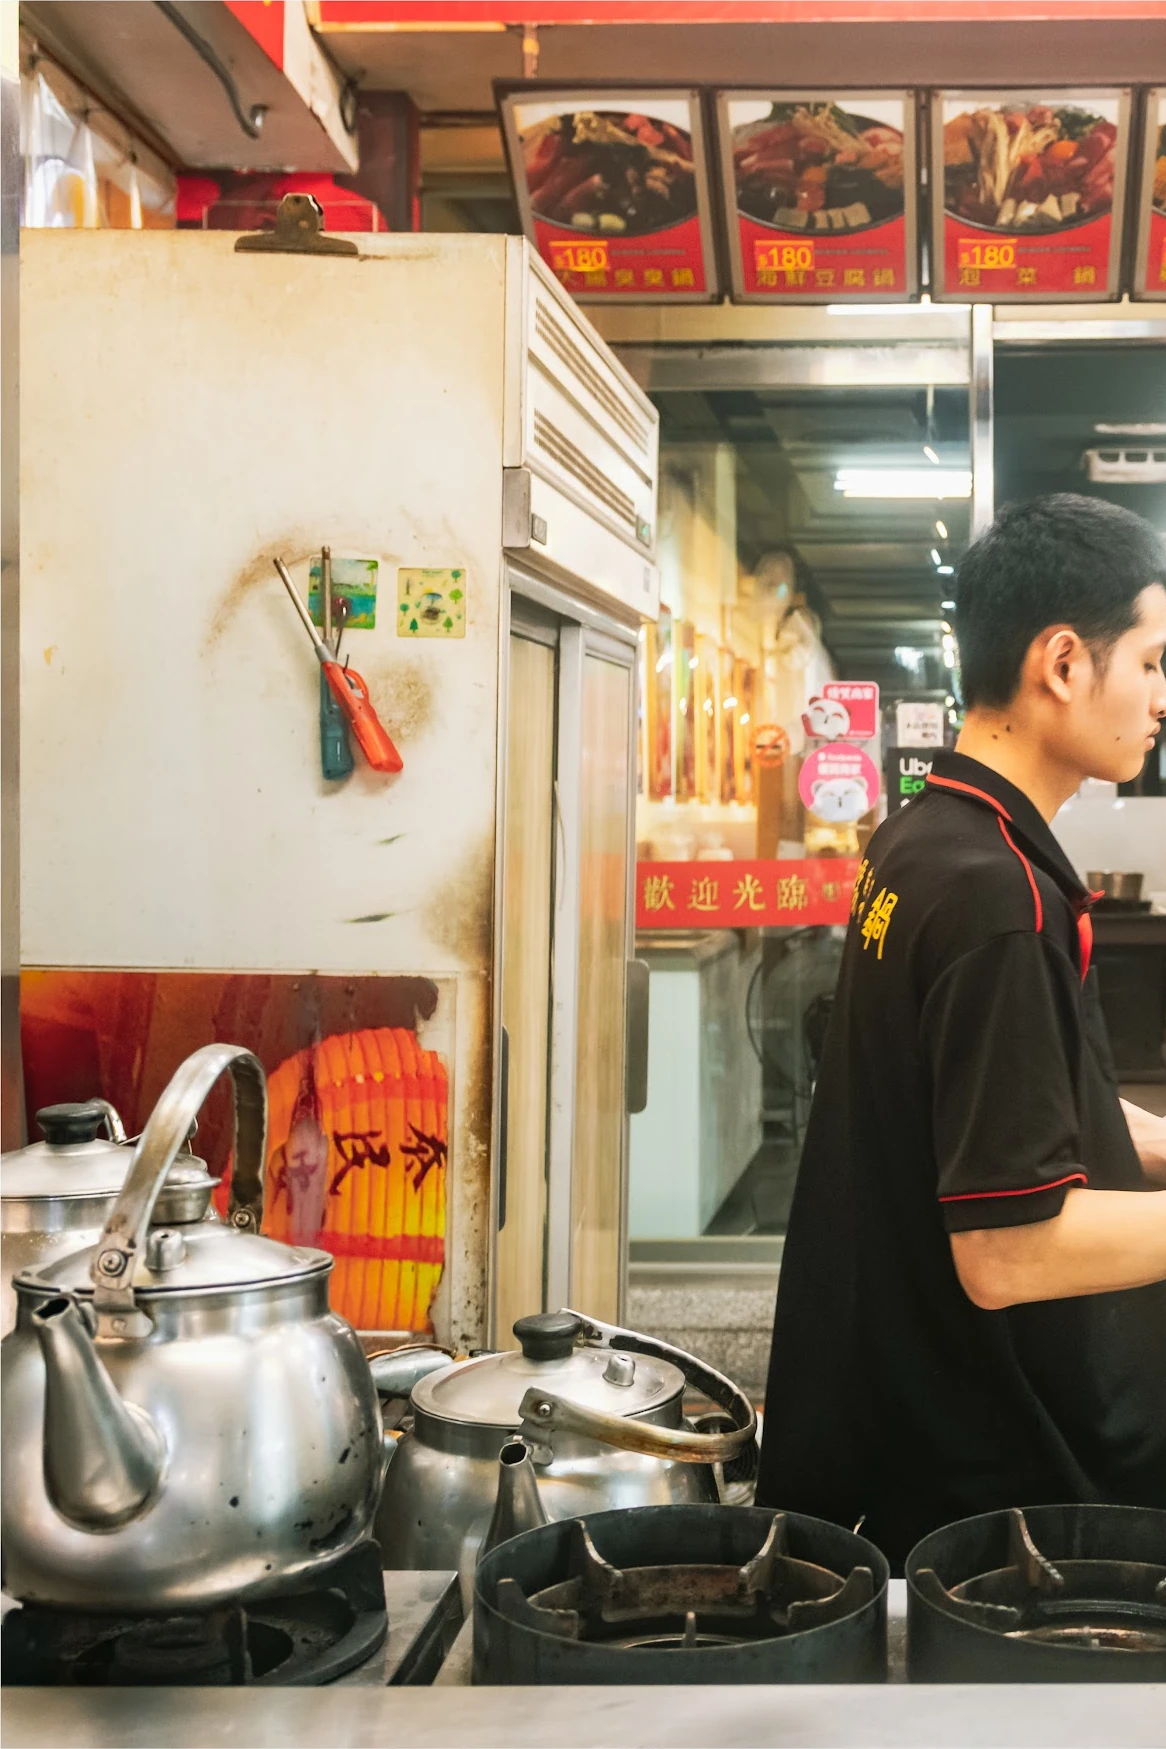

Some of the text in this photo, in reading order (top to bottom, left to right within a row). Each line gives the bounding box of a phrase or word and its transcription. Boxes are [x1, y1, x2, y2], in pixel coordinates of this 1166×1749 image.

[758, 246, 811, 267] $180
[960, 245, 1014, 265] $180
[643, 873, 809, 912] 歡迎光臨
